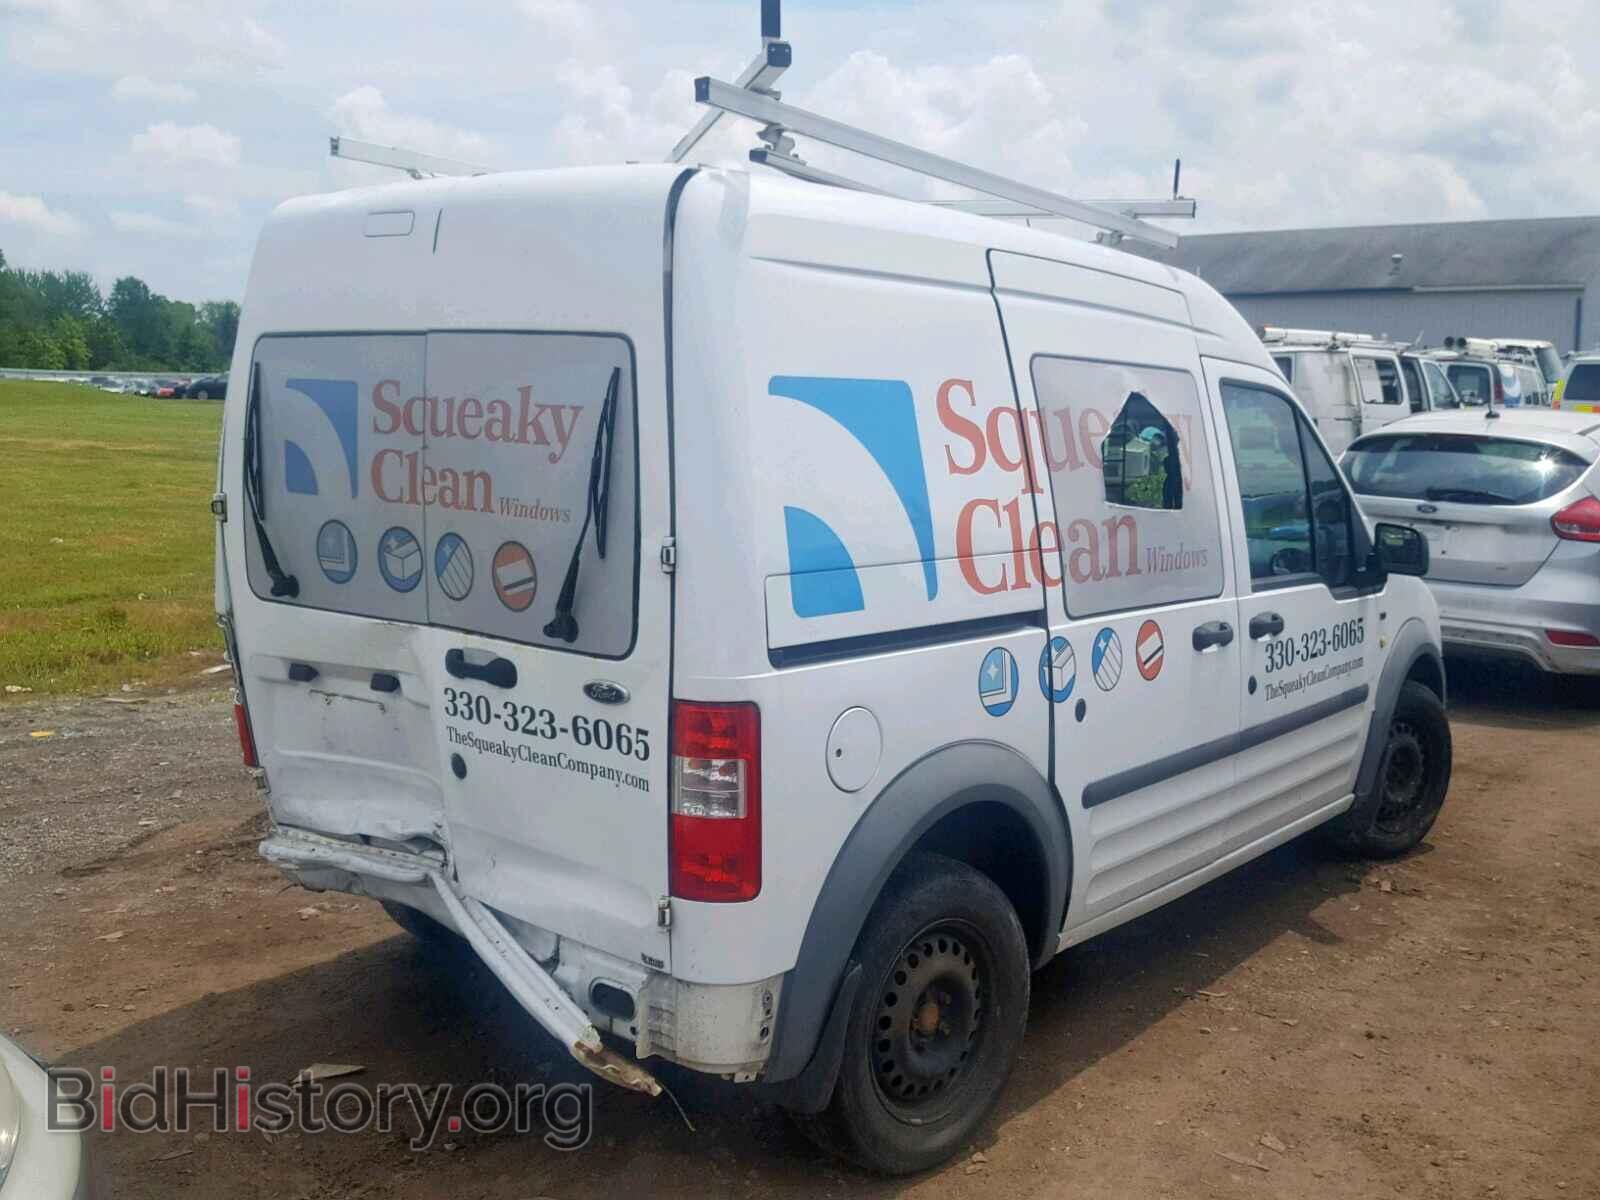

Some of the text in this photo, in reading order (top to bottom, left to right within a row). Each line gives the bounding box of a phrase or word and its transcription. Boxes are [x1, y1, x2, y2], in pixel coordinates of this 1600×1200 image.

[372, 379, 584, 465] Squeaky
[936, 378, 1192, 496] Squey
[371, 448, 572, 524] Clean Windows
[955, 497, 1209, 596] Clean Windows
[1264, 617, 1365, 674] 330-323-6065
[1264, 656, 1364, 702] TheSqueakyCleanCompany.com
[443, 687, 650, 762] 330-323-6065
[446, 725, 650, 793] TheSqueakyCleanCompany.com
